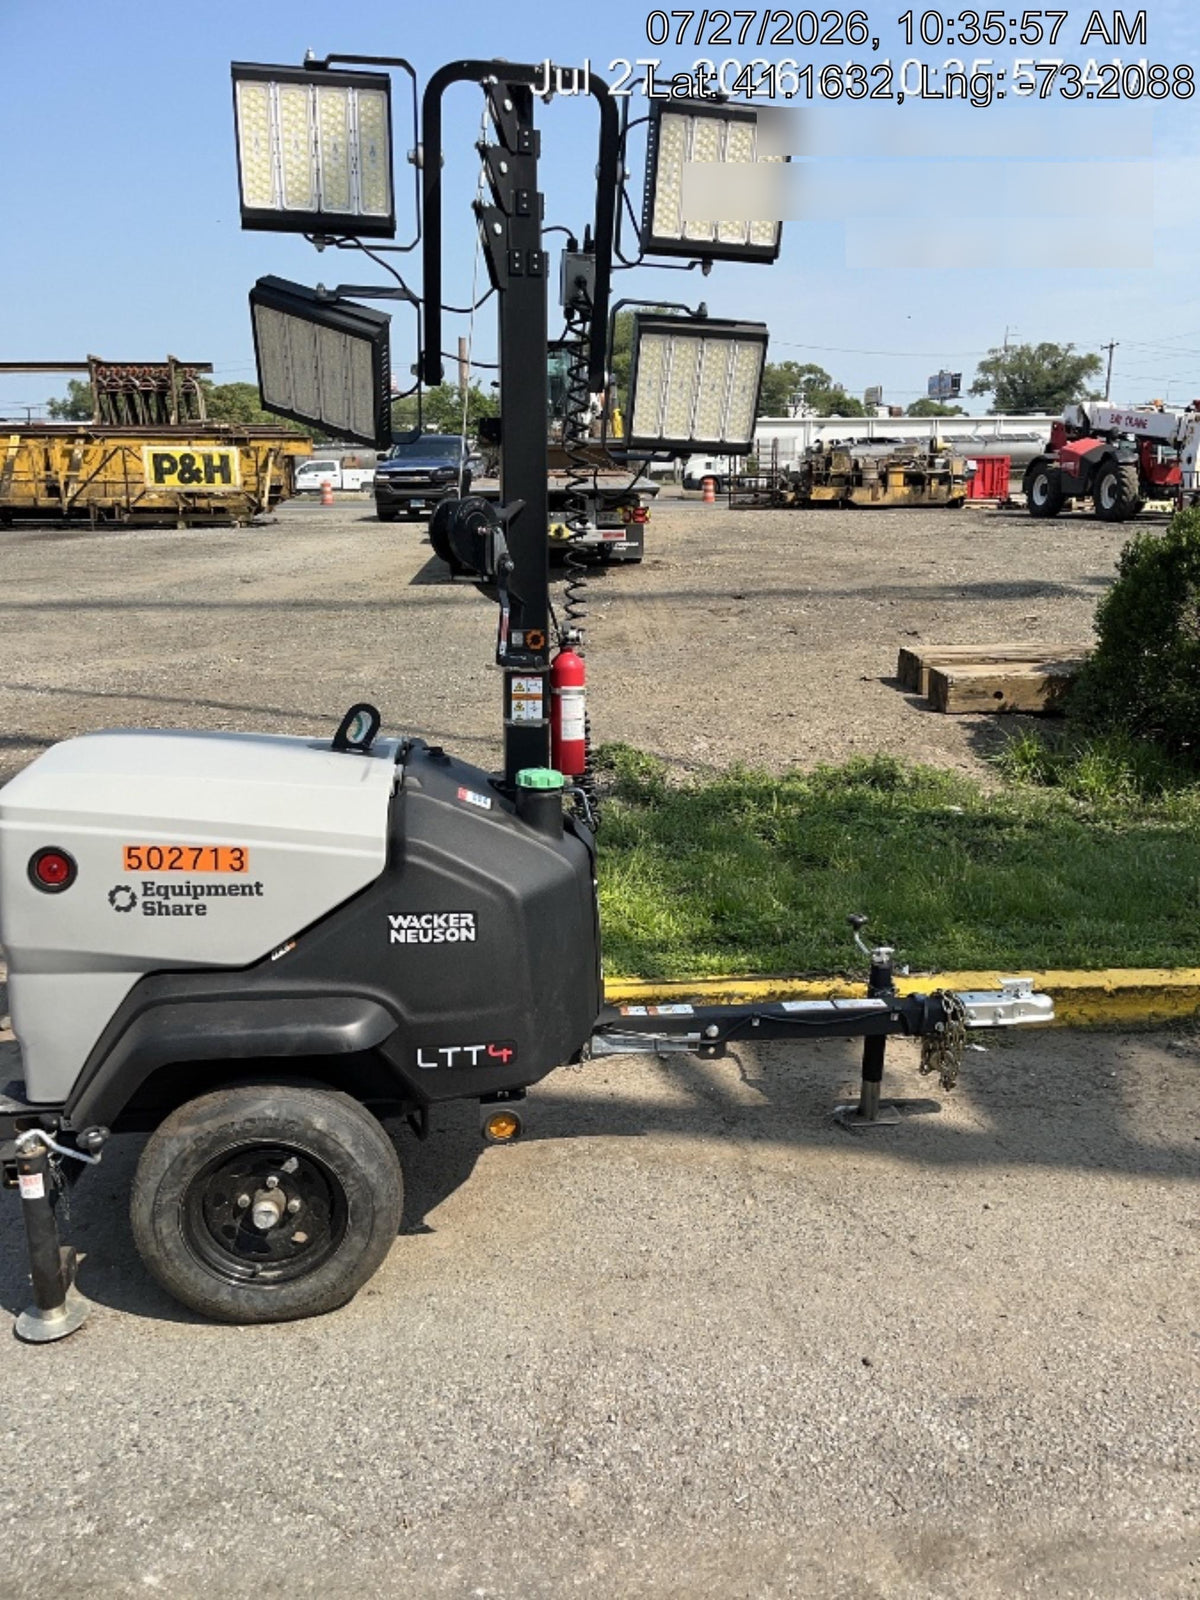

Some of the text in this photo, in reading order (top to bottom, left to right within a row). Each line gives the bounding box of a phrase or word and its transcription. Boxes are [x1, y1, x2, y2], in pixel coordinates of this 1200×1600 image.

[152, 453, 232, 484] P&H
[126, 846, 245, 872] 502713
[141, 881, 264, 900] Equipment
[142, 901, 207, 916] Share
[387, 913, 476, 929] WACKER
[390, 927, 476, 943] NEUSON
[416, 1044, 513, 1068] LTT4
